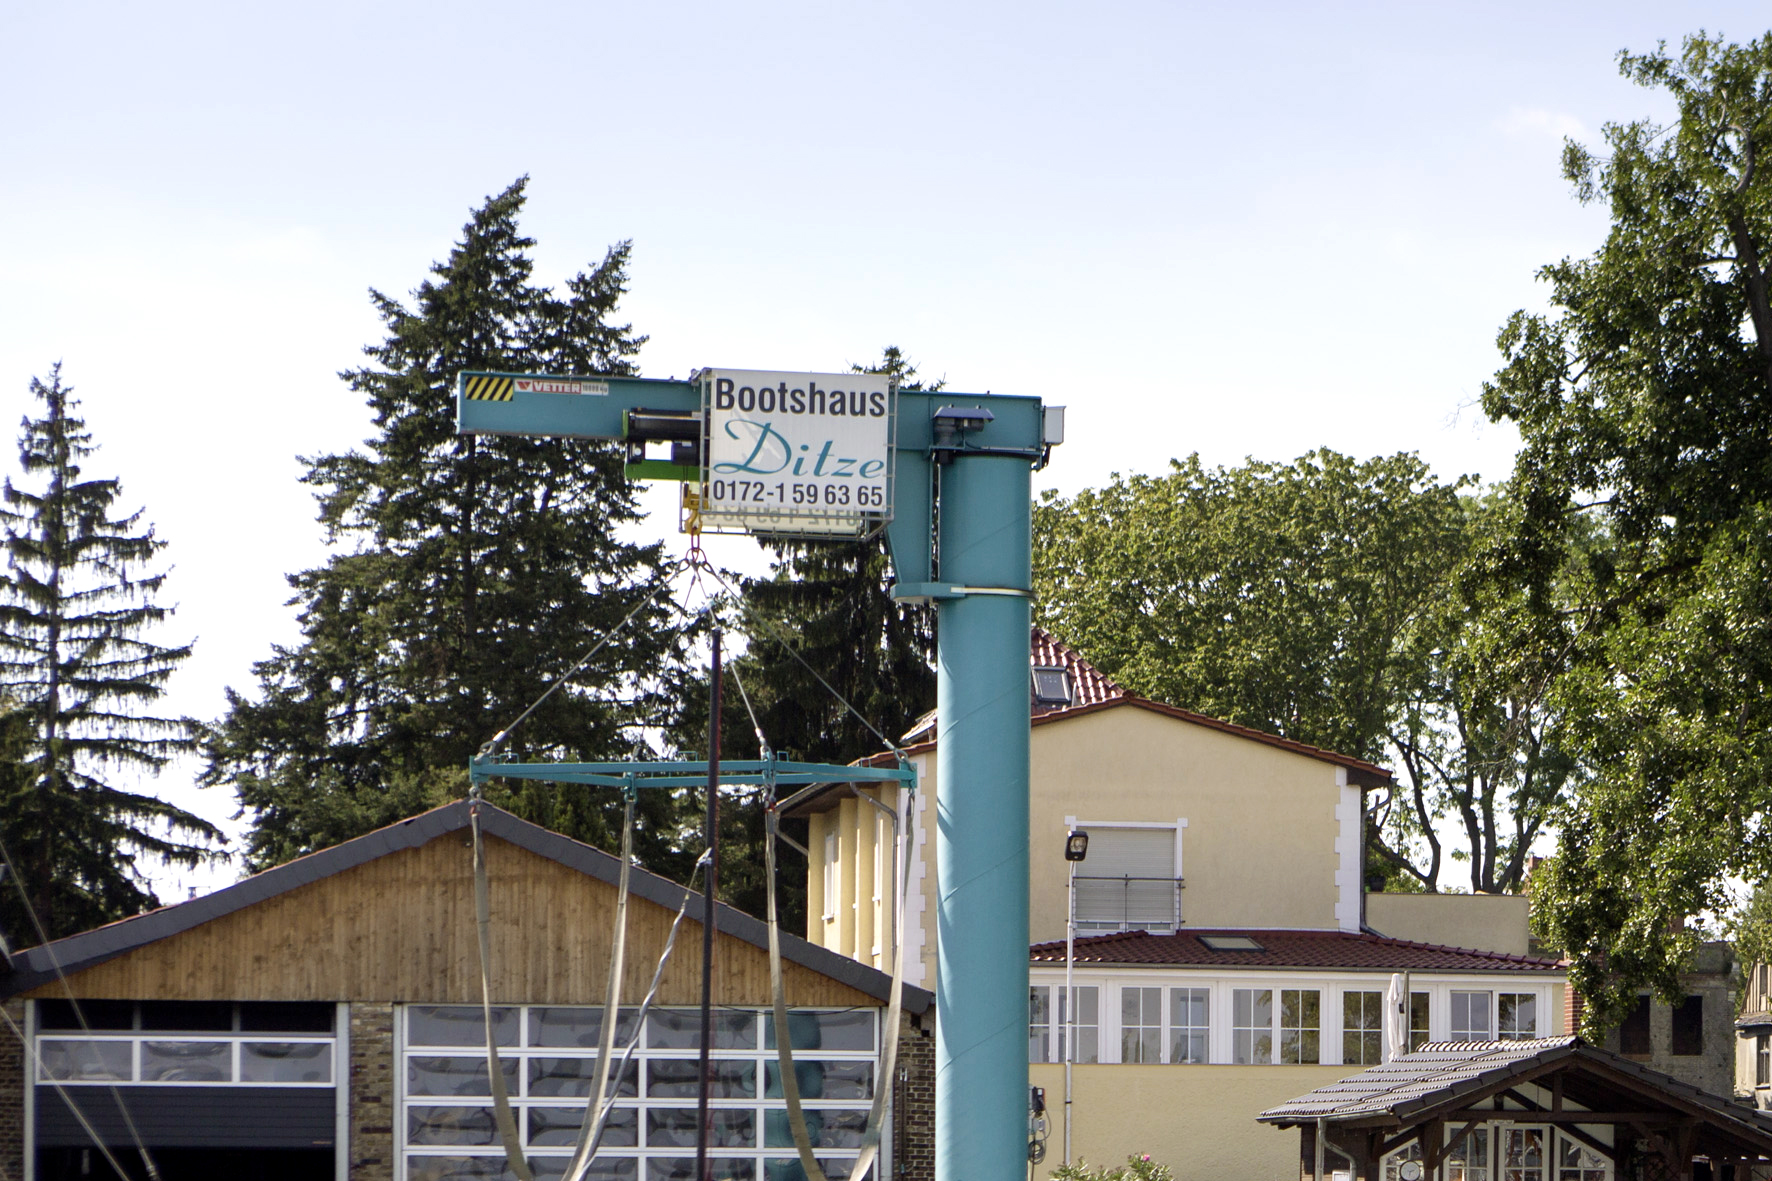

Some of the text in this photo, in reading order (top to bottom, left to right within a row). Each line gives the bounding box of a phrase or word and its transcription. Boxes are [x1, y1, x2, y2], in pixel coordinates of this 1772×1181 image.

[533, 381, 580, 393] VETTER
[715, 378, 886, 417] Bootshaus
[713, 418, 885, 479] Ditze
[713, 480, 883, 506] 0172-1 59 63 65
